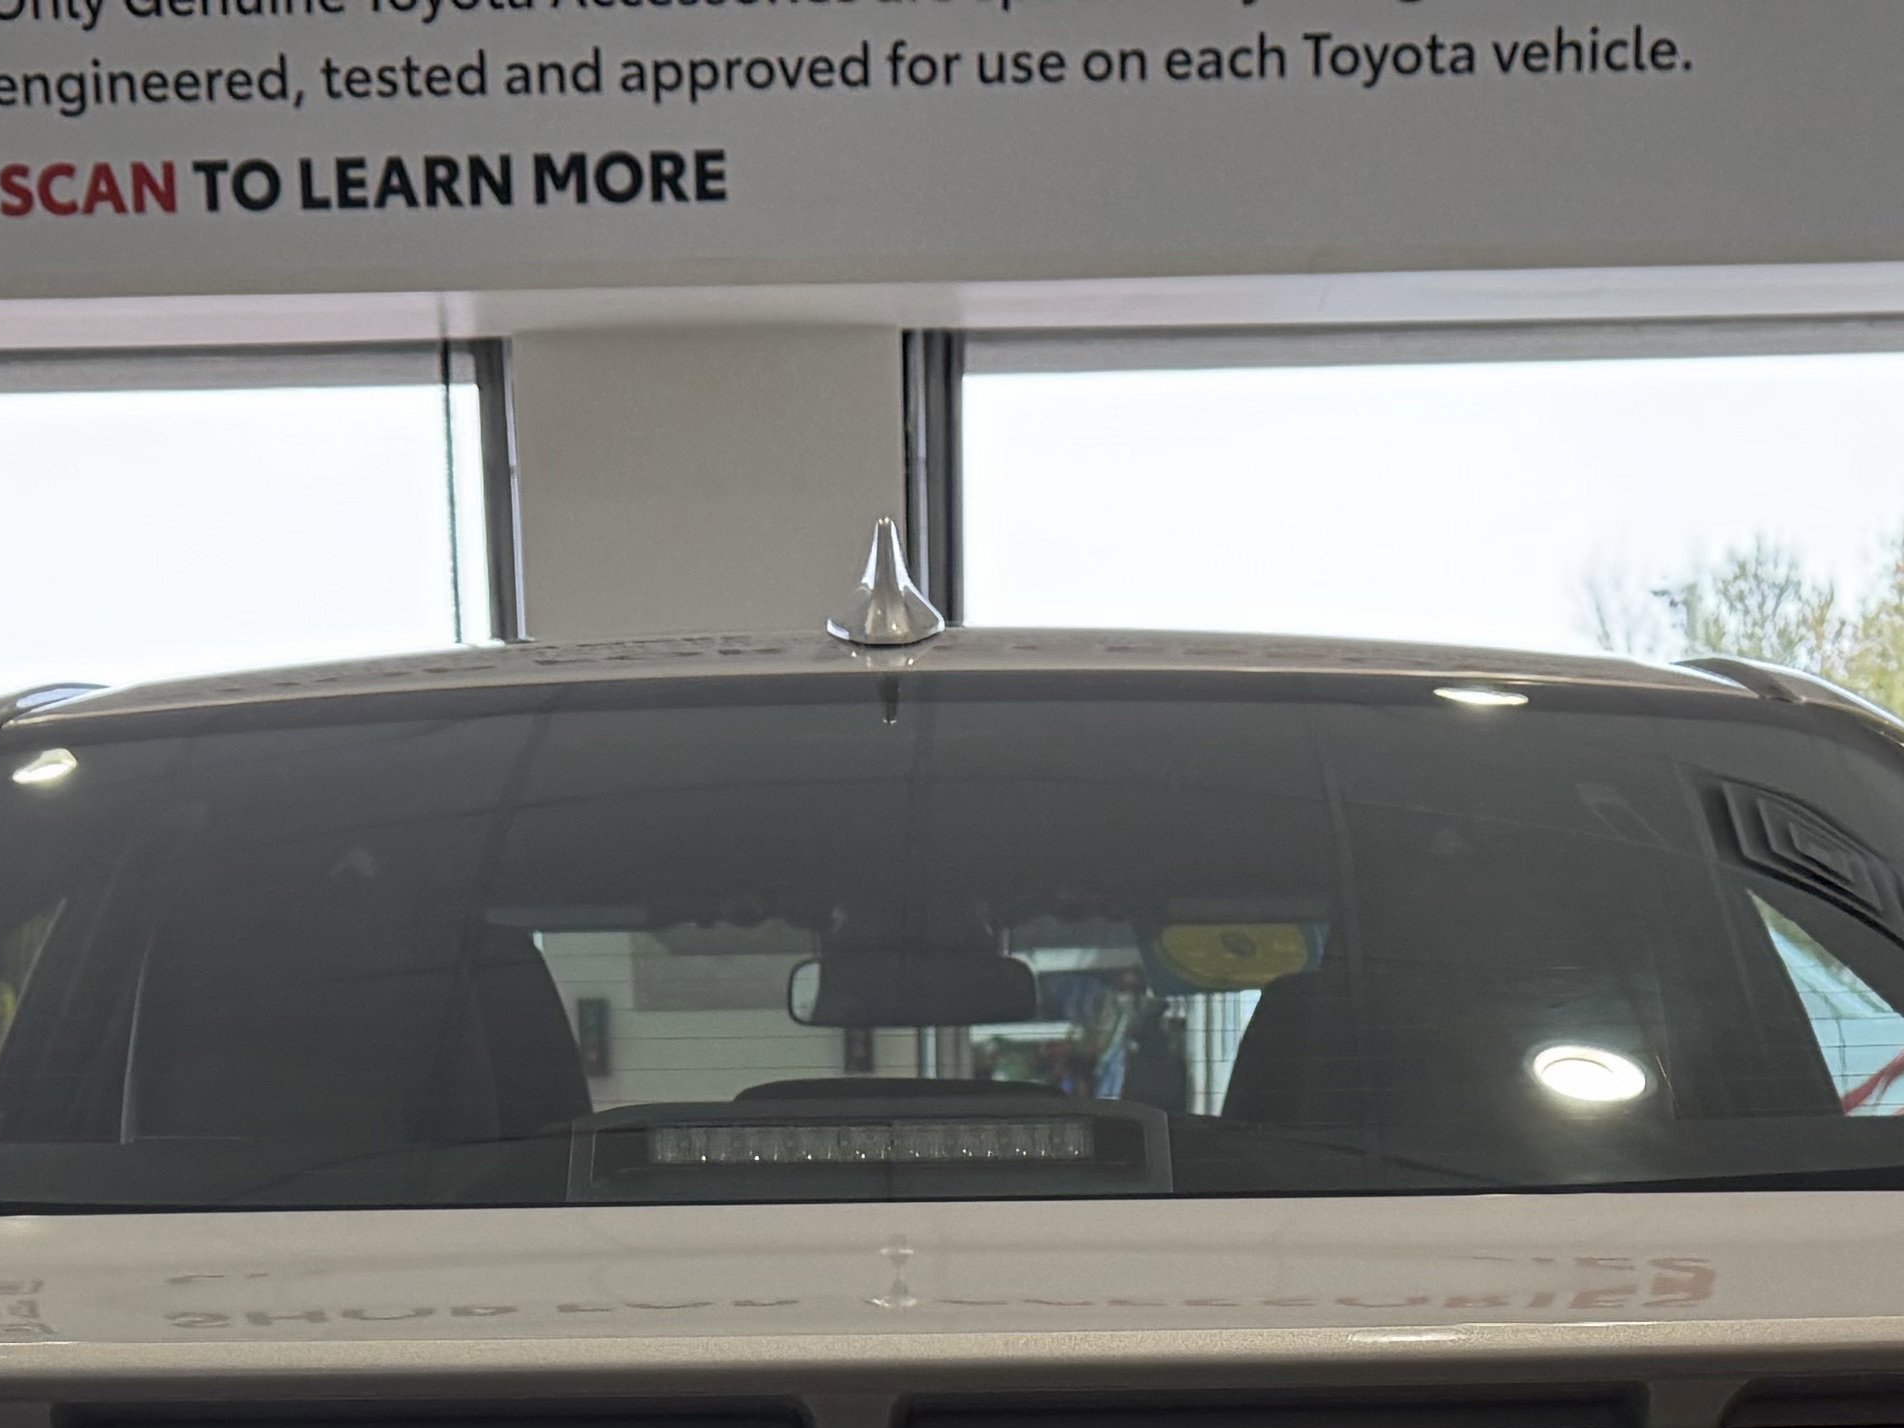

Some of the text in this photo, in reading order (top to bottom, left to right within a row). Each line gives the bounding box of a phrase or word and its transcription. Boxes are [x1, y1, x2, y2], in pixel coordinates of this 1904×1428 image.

[321, 48, 488, 101] tested
[505, 44, 601, 95] and
[619, 39, 871, 104] approved
[887, 38, 961, 87] for
[977, 48, 1068, 85] use
[1082, 47, 1147, 83] on
[1164, 31, 1287, 82] each
[1302, 31, 1477, 89] Toyota
[1493, 24, 1693, 75] vehicle.
[192, 158, 282, 212] TO
[299, 153, 514, 211] LEARN
[532, 148, 728, 206] MORE
